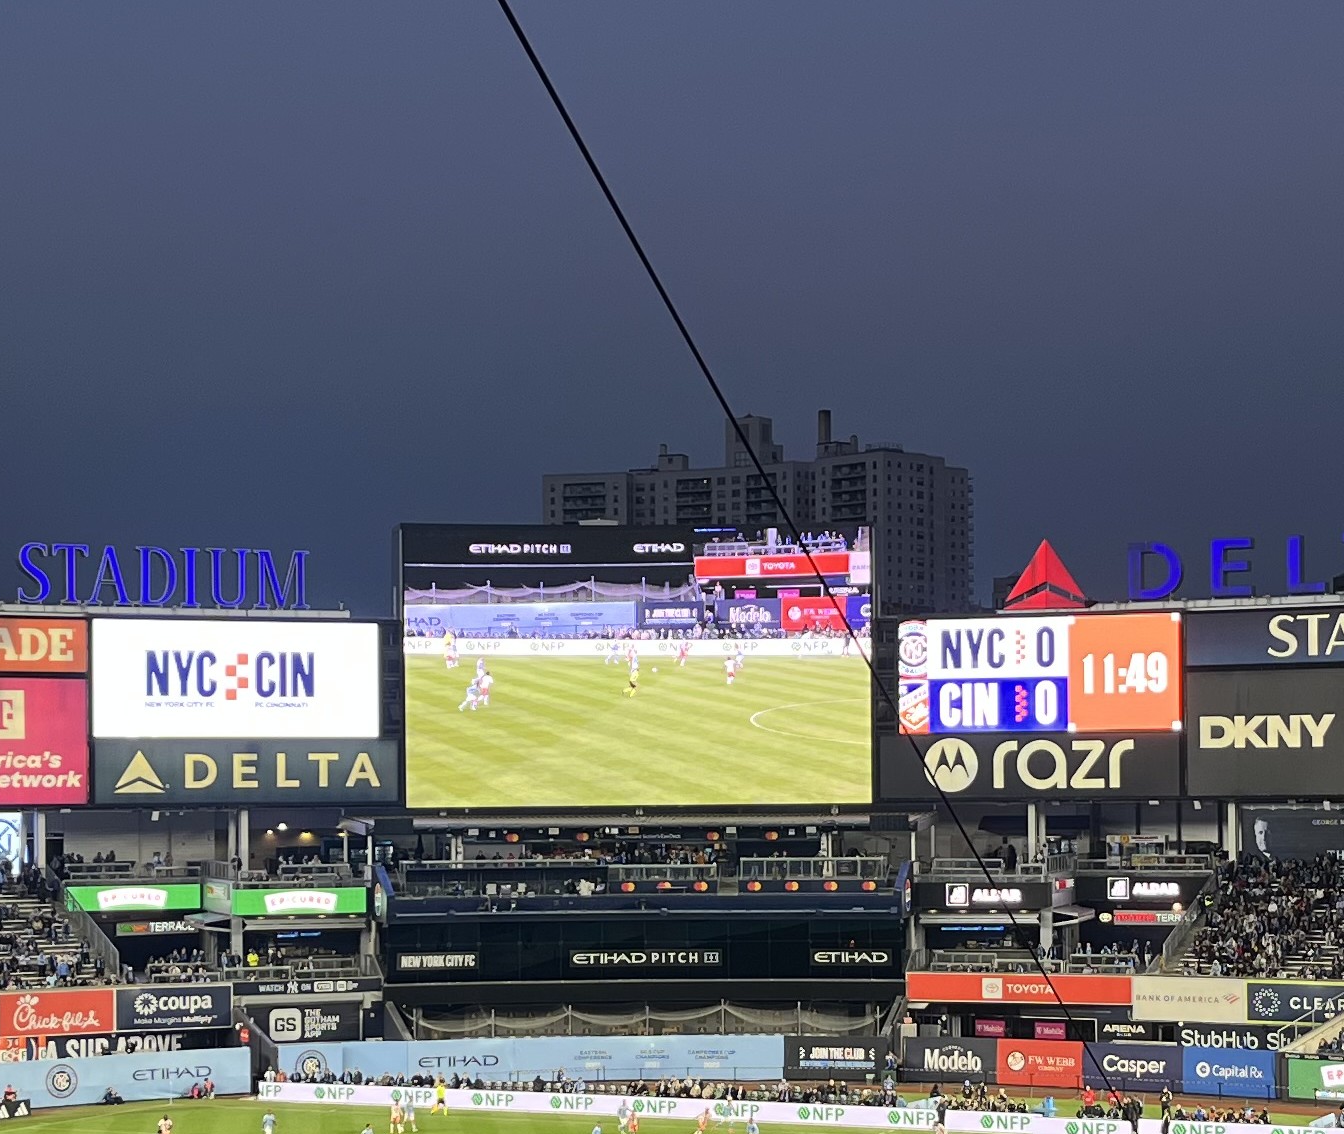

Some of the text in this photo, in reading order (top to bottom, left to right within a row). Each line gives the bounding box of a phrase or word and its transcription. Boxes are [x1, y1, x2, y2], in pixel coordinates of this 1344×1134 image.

[469, 544, 556, 553] ETIHAD PITCH
[633, 543, 684, 553] ETIHAD
[762, 562, 795, 570] TOYOTA
[17, 541, 310, 610] STADIUM
[729, 607, 771, 623] Modelo
[941, 626, 1055, 669] NYC 0
[146, 650, 217, 697] NYC
[256, 652, 315, 697] CIN
[1082, 652, 1168, 694] 11:49
[939, 680, 1057, 727] CIN 0
[1199, 714, 1335, 748] DKNY
[993, 739, 1134, 789] razr
[185, 753, 381, 789] DELTA
[401, 953, 475, 968] NEW YORK CITY FC
[572, 952, 698, 964] ETIHAD PITCH
[814, 951, 889, 963] ETIHAD
[1006, 983, 1054, 994] TOYOTA
[159, 994, 212, 1013] coupa
[1136, 994, 1219, 1004] BANK OF AMERICA
[13, 1004, 100, 1032] Chick-fil-A
[154, 1017, 181, 1025] Margins
[182, 1016, 212, 1024] Multiply
[275, 1018, 296, 1031] GS
[304, 1015, 339, 1024] GOTHAM
[304, 1023, 337, 1031] SPORTS
[1103, 1024, 1145, 1033] ARENA
[810, 1048, 864, 1059] JOIN THE CLUB
[924, 1049, 981, 1071] Modelo
[418, 1055, 499, 1068] ETIHAD
[1048, 1057, 1075, 1067] WEBB
[1103, 1055, 1165, 1078] Casper
[133, 1066, 212, 1081] ETIHAD
[1212, 1065, 1263, 1079] Capital Rx
[485, 1094, 514, 1106] NFP
[812, 1107, 844, 1120] NFP
